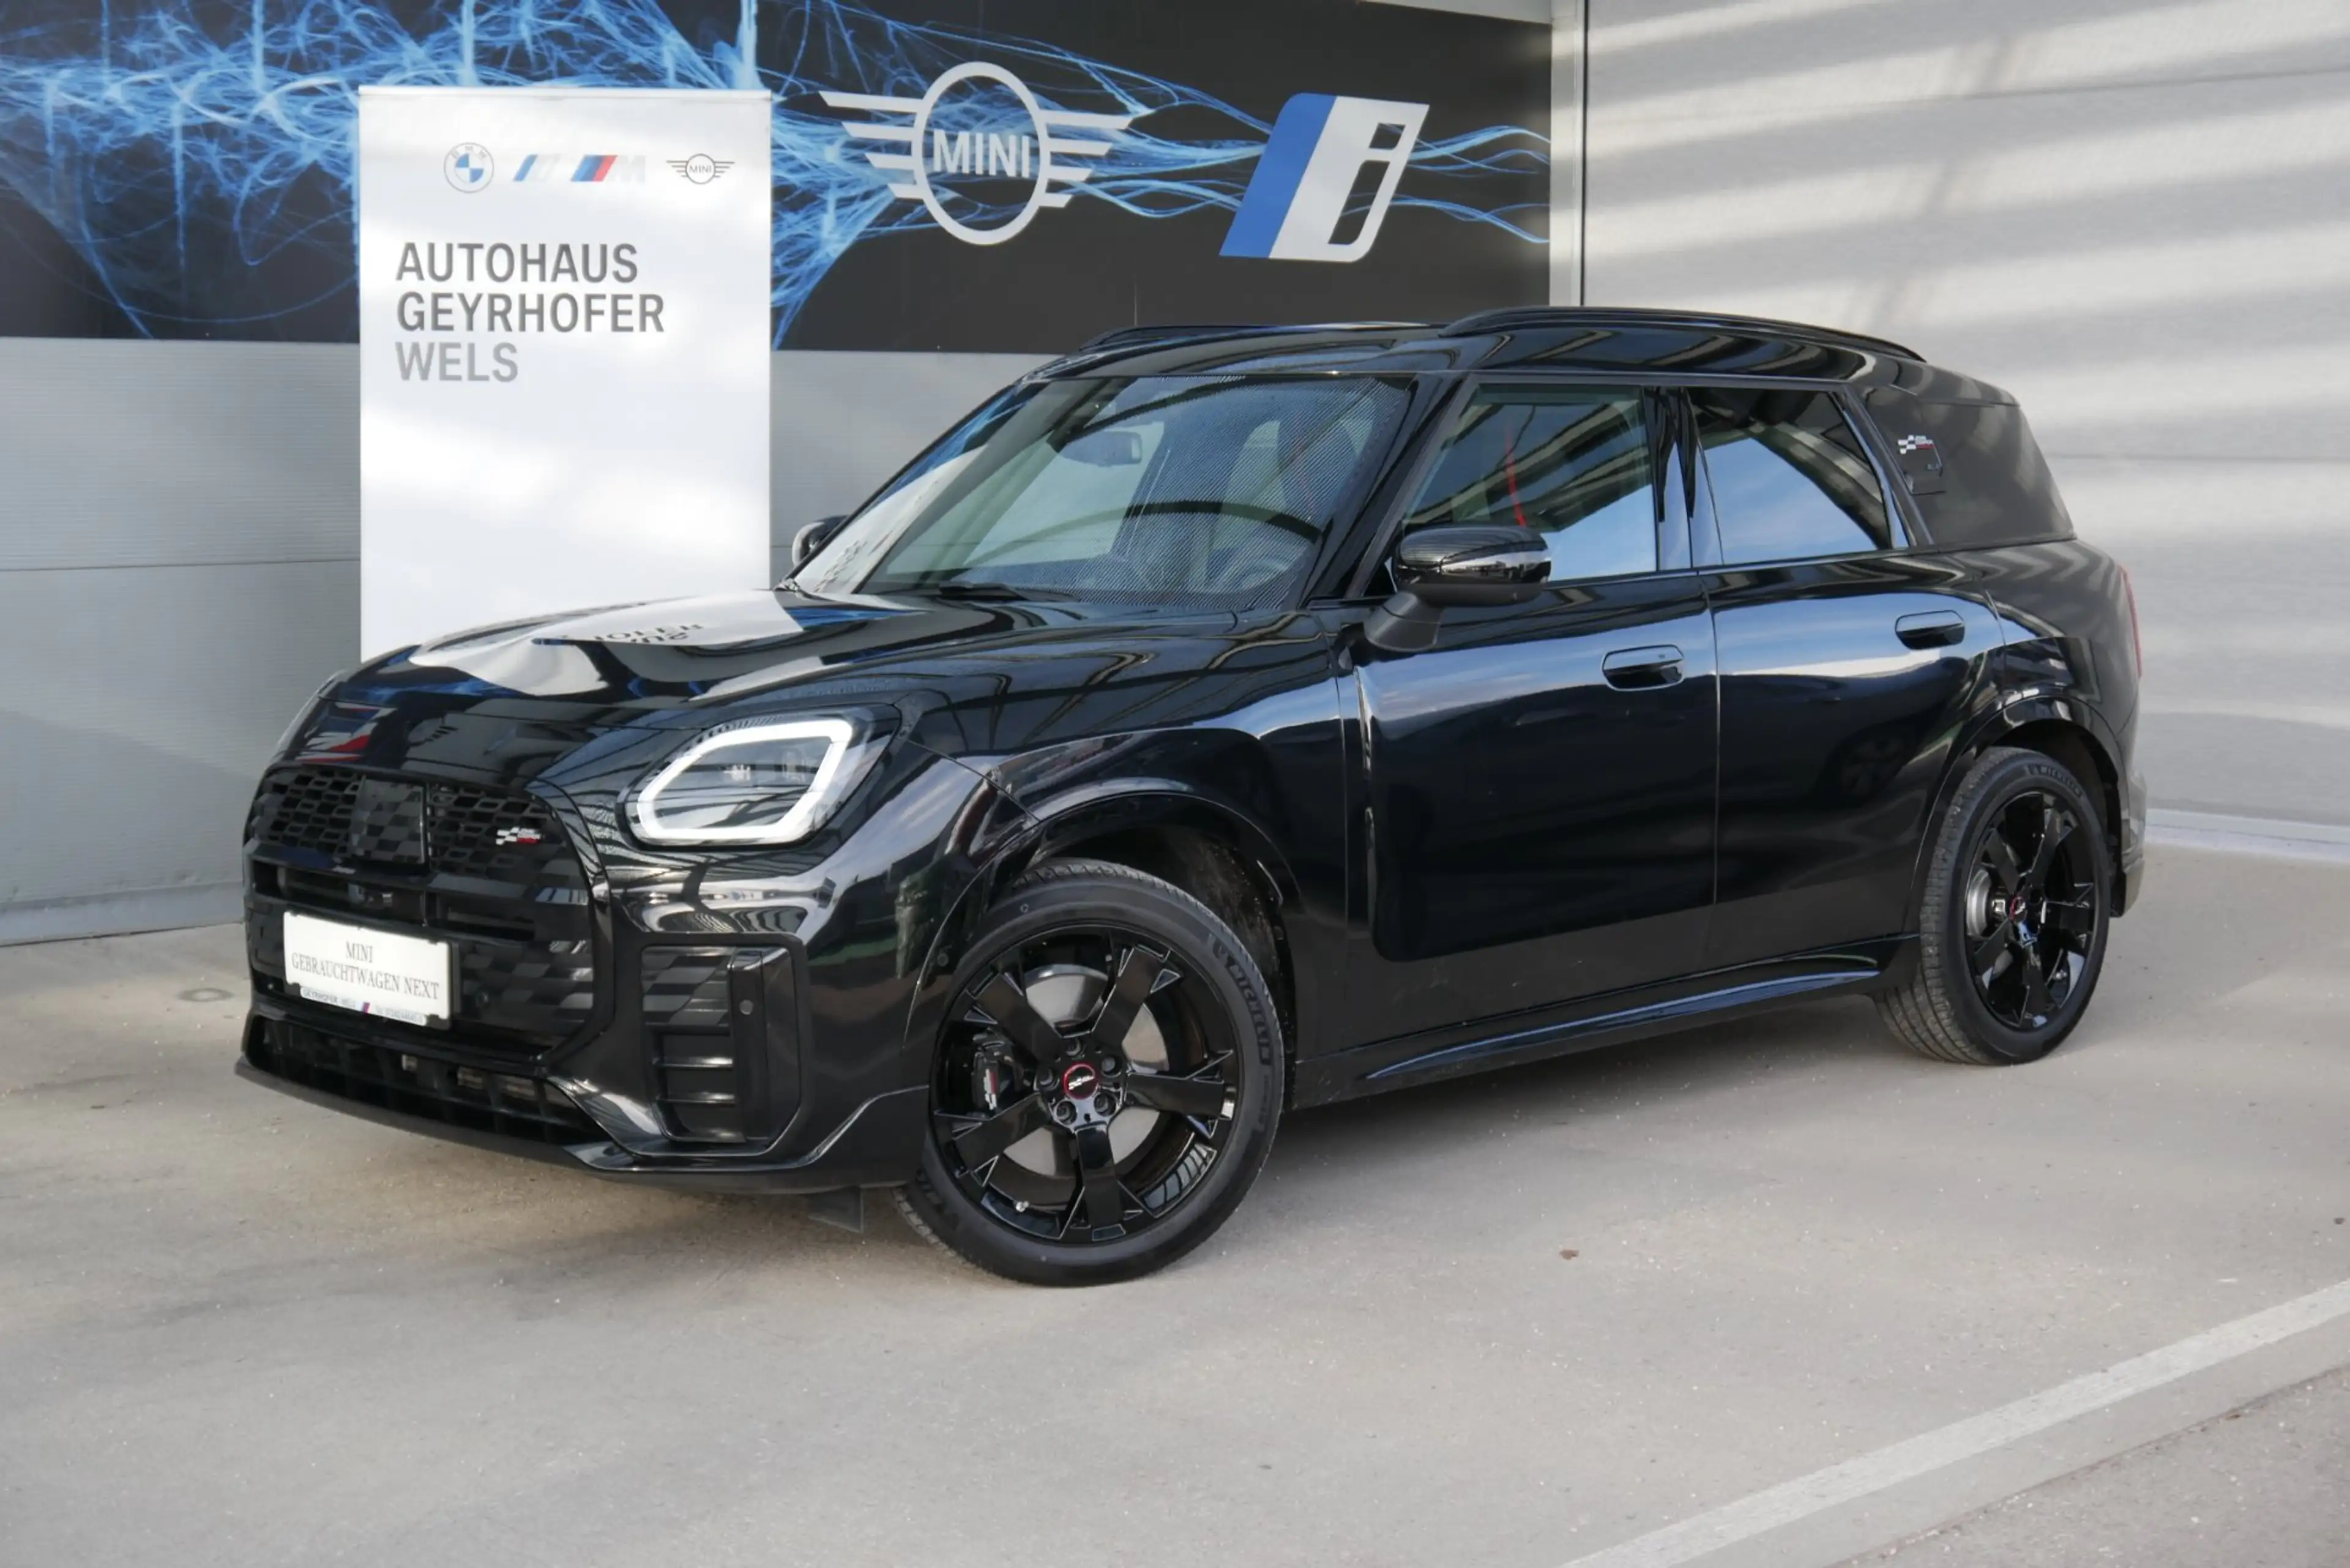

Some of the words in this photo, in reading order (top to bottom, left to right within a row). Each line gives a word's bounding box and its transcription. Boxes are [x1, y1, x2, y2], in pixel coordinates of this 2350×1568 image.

[689, 164, 712, 174] MINI
[933, 128, 1031, 178] MINI
[395, 242, 638, 283] AUTOHAUS
[396, 291, 665, 333] GEYRHOFER
[395, 341, 518, 383] WELS
[345, 941, 374, 963] MINI
[291, 952, 400, 993] GEBRAUCHTWAGEN
[404, 975, 440, 1000] NEXT
